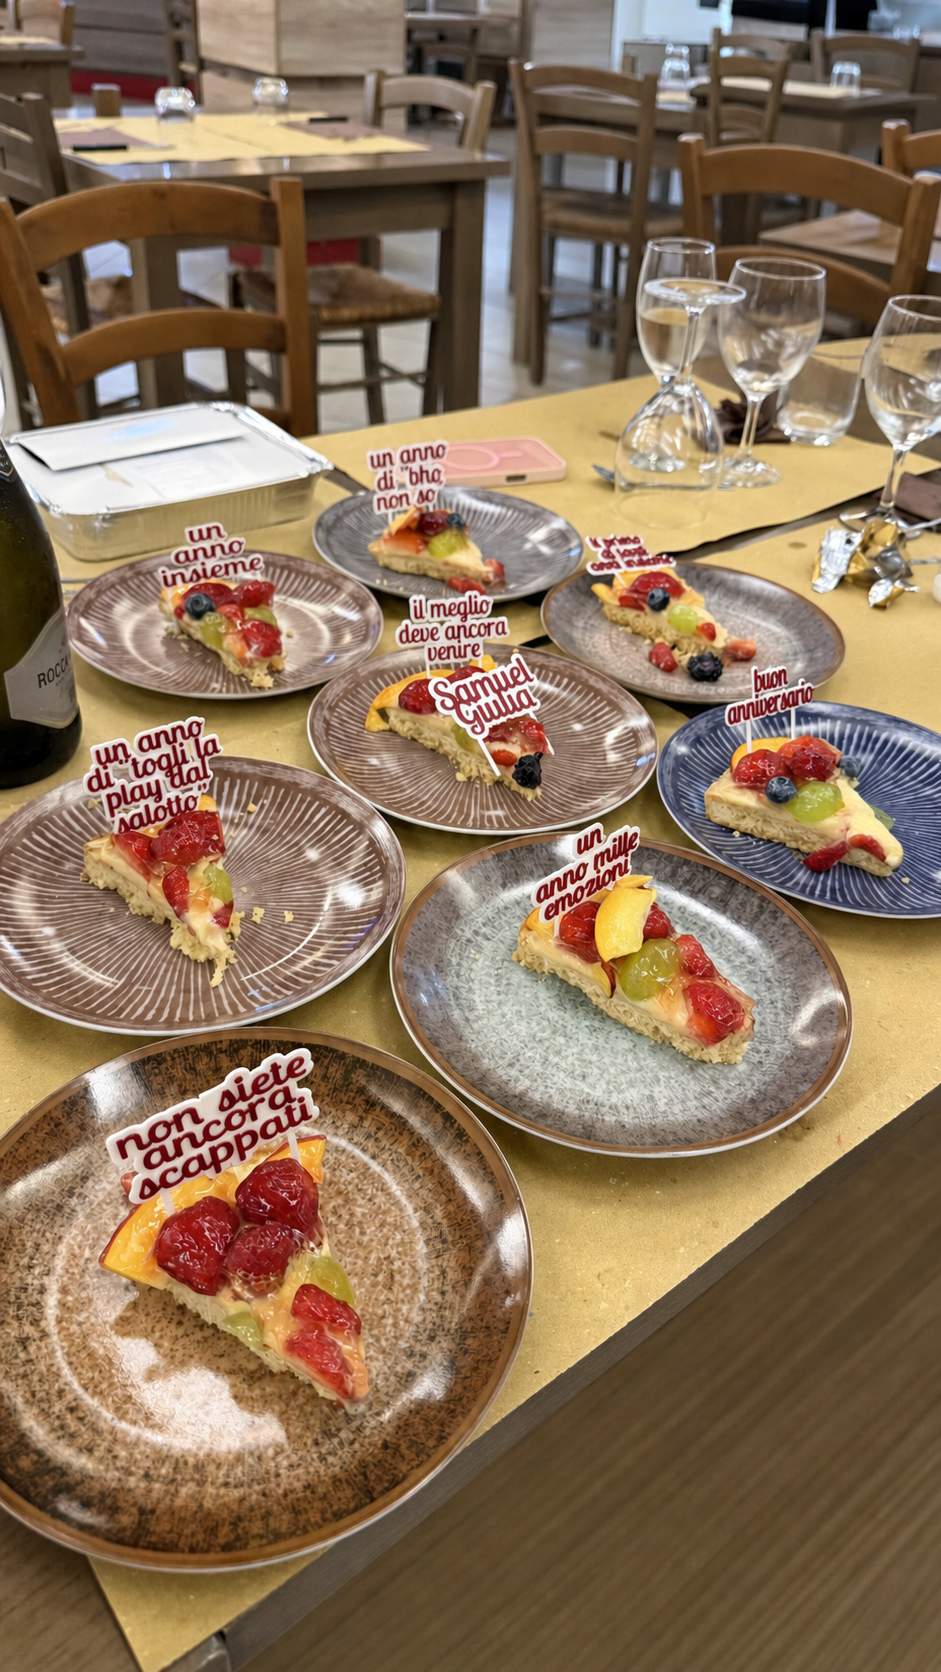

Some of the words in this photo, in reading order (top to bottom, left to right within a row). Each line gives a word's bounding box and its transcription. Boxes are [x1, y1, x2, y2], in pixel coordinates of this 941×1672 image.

[370, 452, 395, 469] un
[400, 444, 446, 464] anno
[377, 470, 395, 491] di
[376, 493, 411, 511] non
[416, 488, 436, 504] so
[174, 540, 244, 564] anno
[188, 525, 226, 543] un
[161, 557, 263, 588] insieme
[412, 598, 425, 620] il
[430, 595, 490, 623] meglio
[399, 624, 440, 644] deve
[444, 620, 508, 642] ancora
[427, 640, 481, 661] venire
[433, 657, 535, 711] Samuel
[754, 668, 788, 693] buon
[455, 690, 538, 735] Giulia
[727, 681, 814, 725] anniversario
[95, 742, 131, 765] un
[138, 720, 203, 753] anno
[87, 765, 115, 792] di
[194, 738, 221, 759] la
[105, 779, 163, 818] play
[170, 757, 211, 789] dal
[577, 828, 602, 855] un
[536, 862, 589, 904] anno
[593, 831, 638, 871] mille
[544, 853, 630, 921] emozioni
[116, 1107, 204, 1160] non
[218, 1056, 307, 1112] siete
[143, 1085, 297, 1170] ancora
[139, 1096, 312, 1200] scappati
